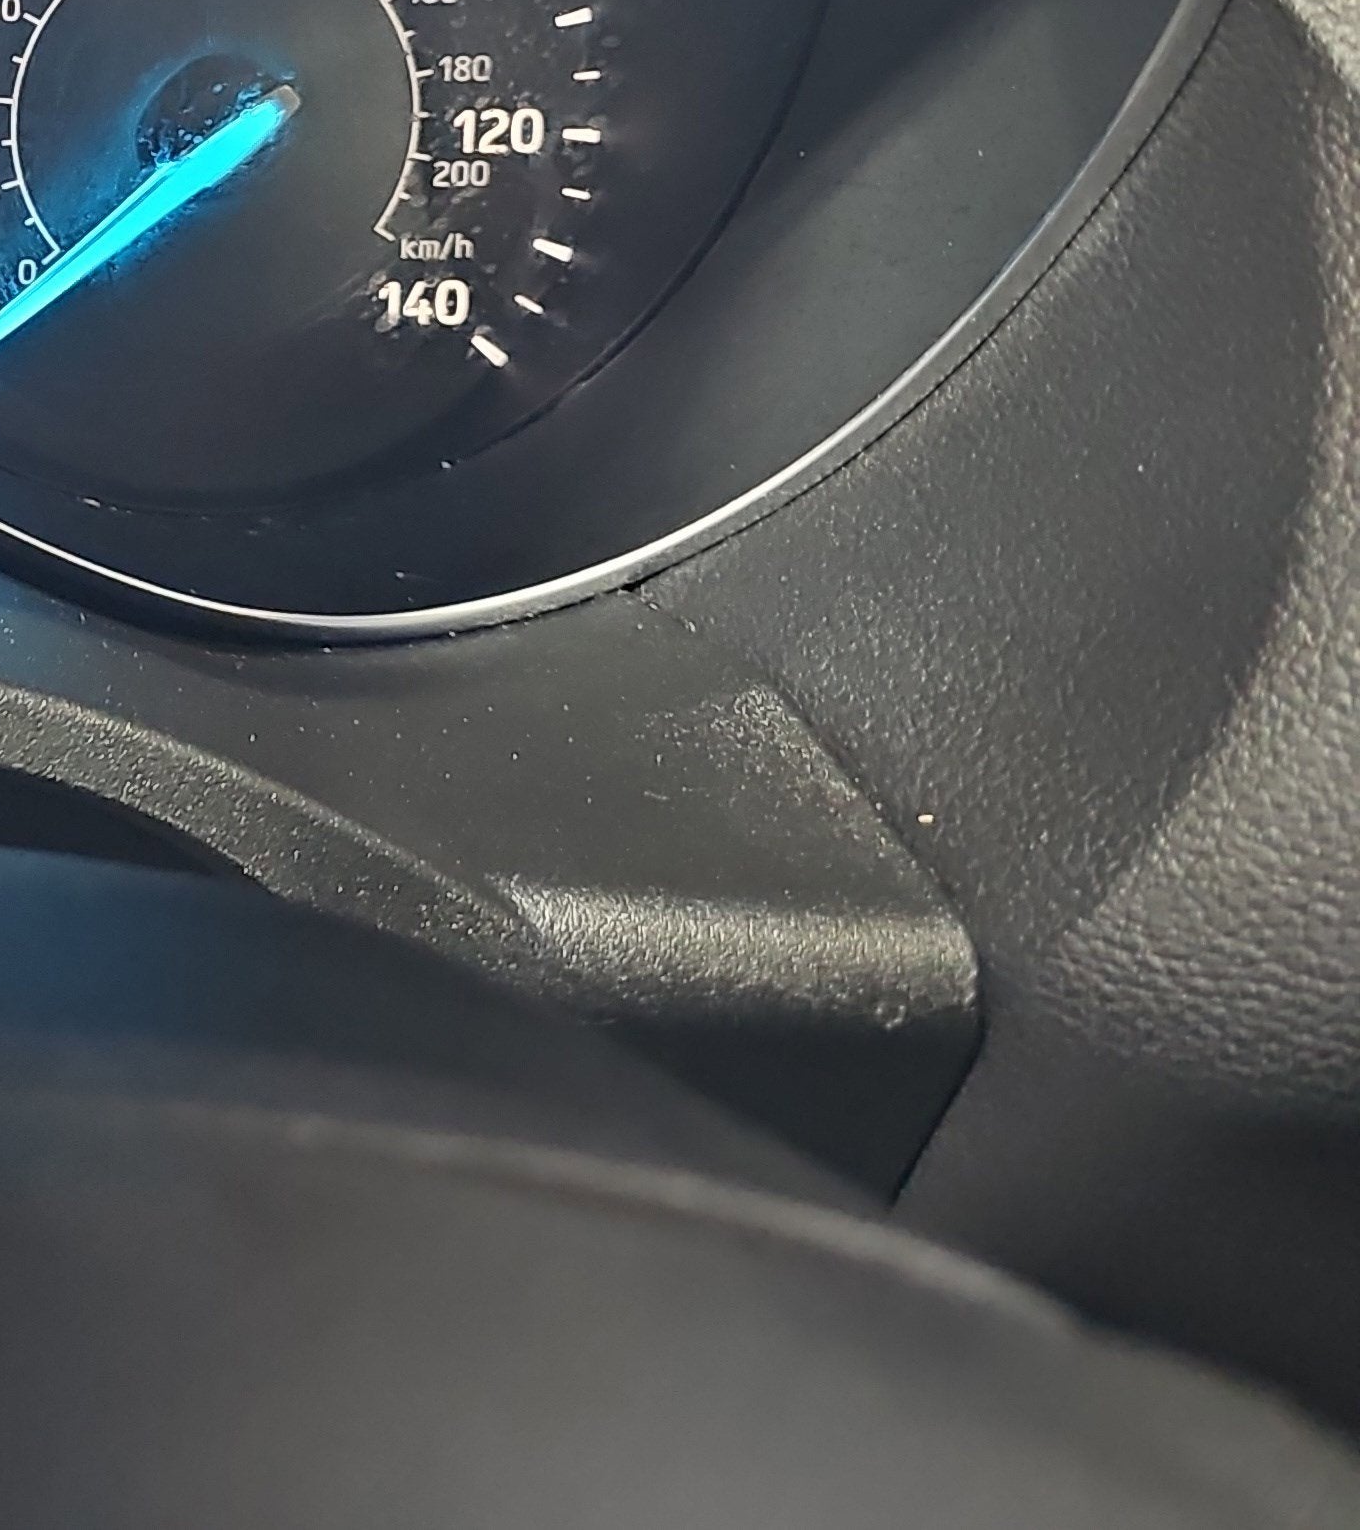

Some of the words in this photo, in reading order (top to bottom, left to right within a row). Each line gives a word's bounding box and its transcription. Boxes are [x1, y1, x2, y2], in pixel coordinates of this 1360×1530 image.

[438, 56, 491, 82] 180
[454, 109, 544, 155] 120
[433, 162, 488, 188] 200
[400, 233, 474, 262] km/h
[17, 260, 37, 285] 0
[379, 281, 470, 325] 140
